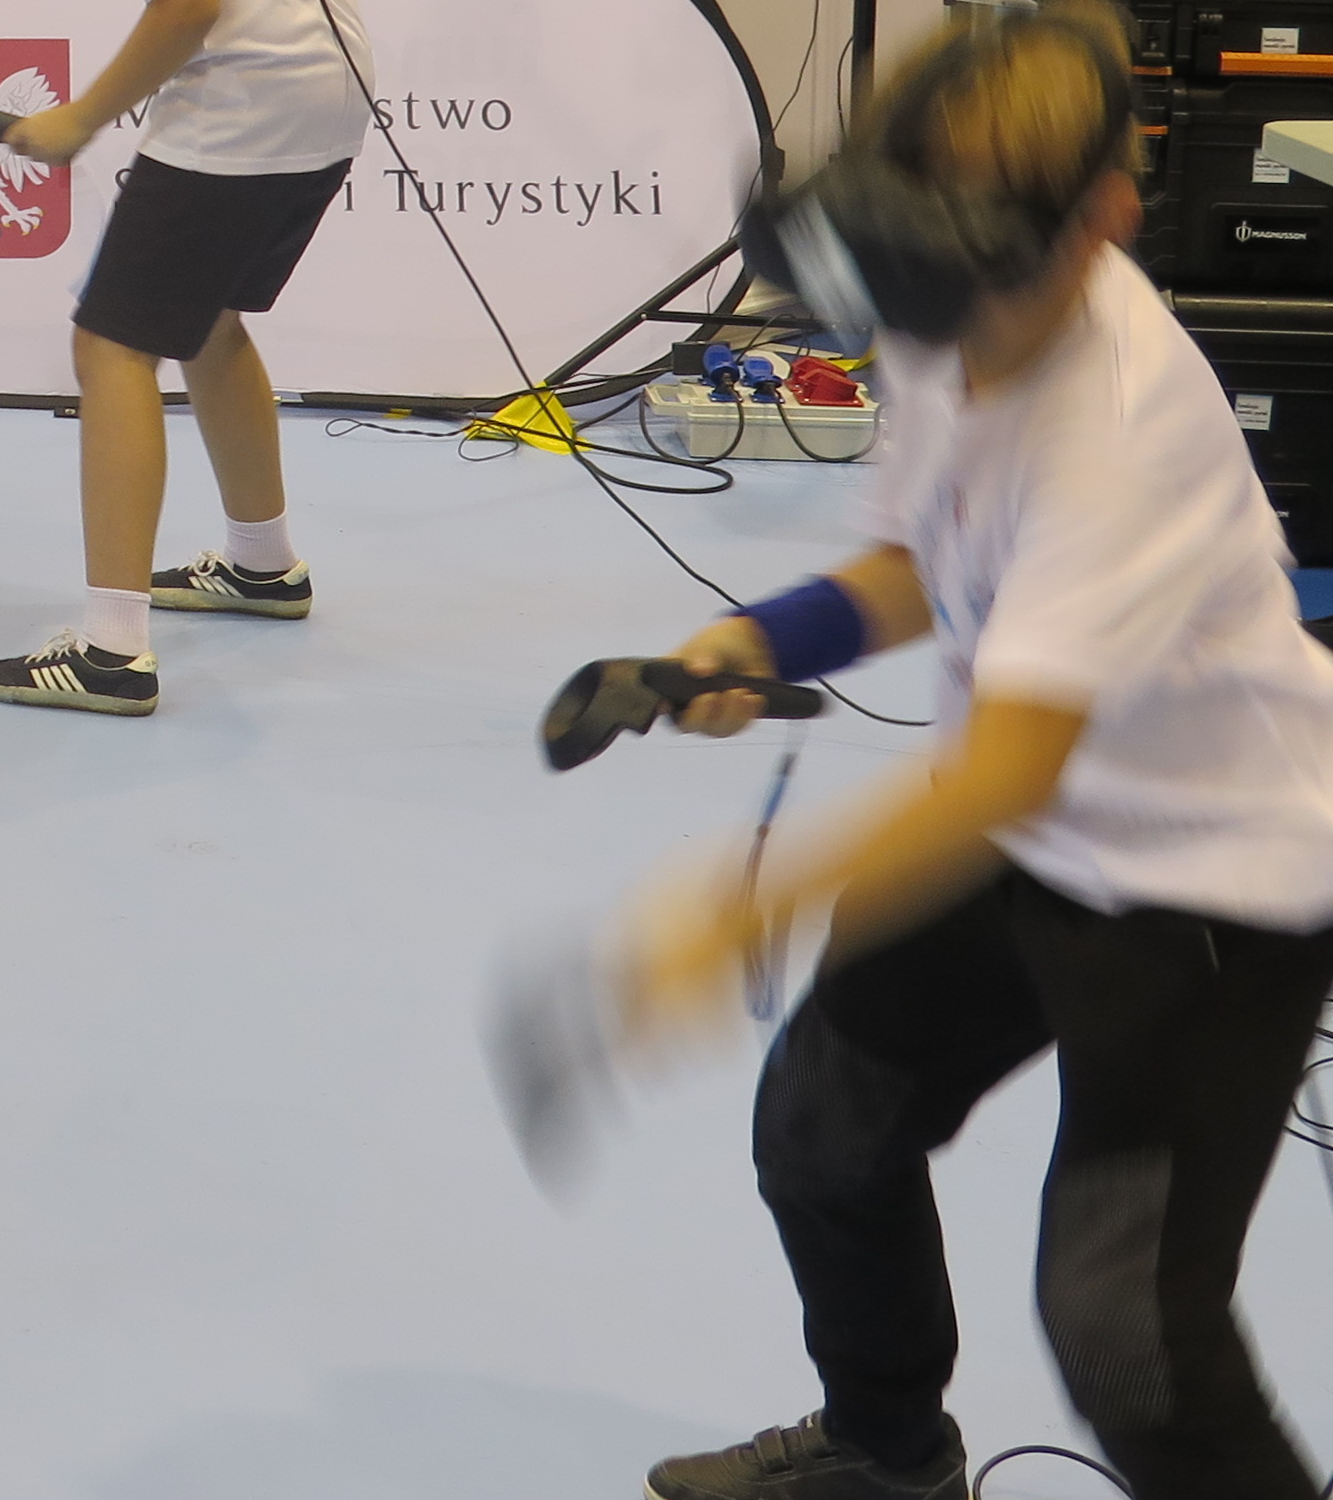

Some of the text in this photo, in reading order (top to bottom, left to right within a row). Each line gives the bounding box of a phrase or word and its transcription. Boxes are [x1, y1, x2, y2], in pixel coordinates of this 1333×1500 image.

[344, 169, 664, 226] i Turystyki
[1252, 230, 1308, 241] MAGNUSSON
